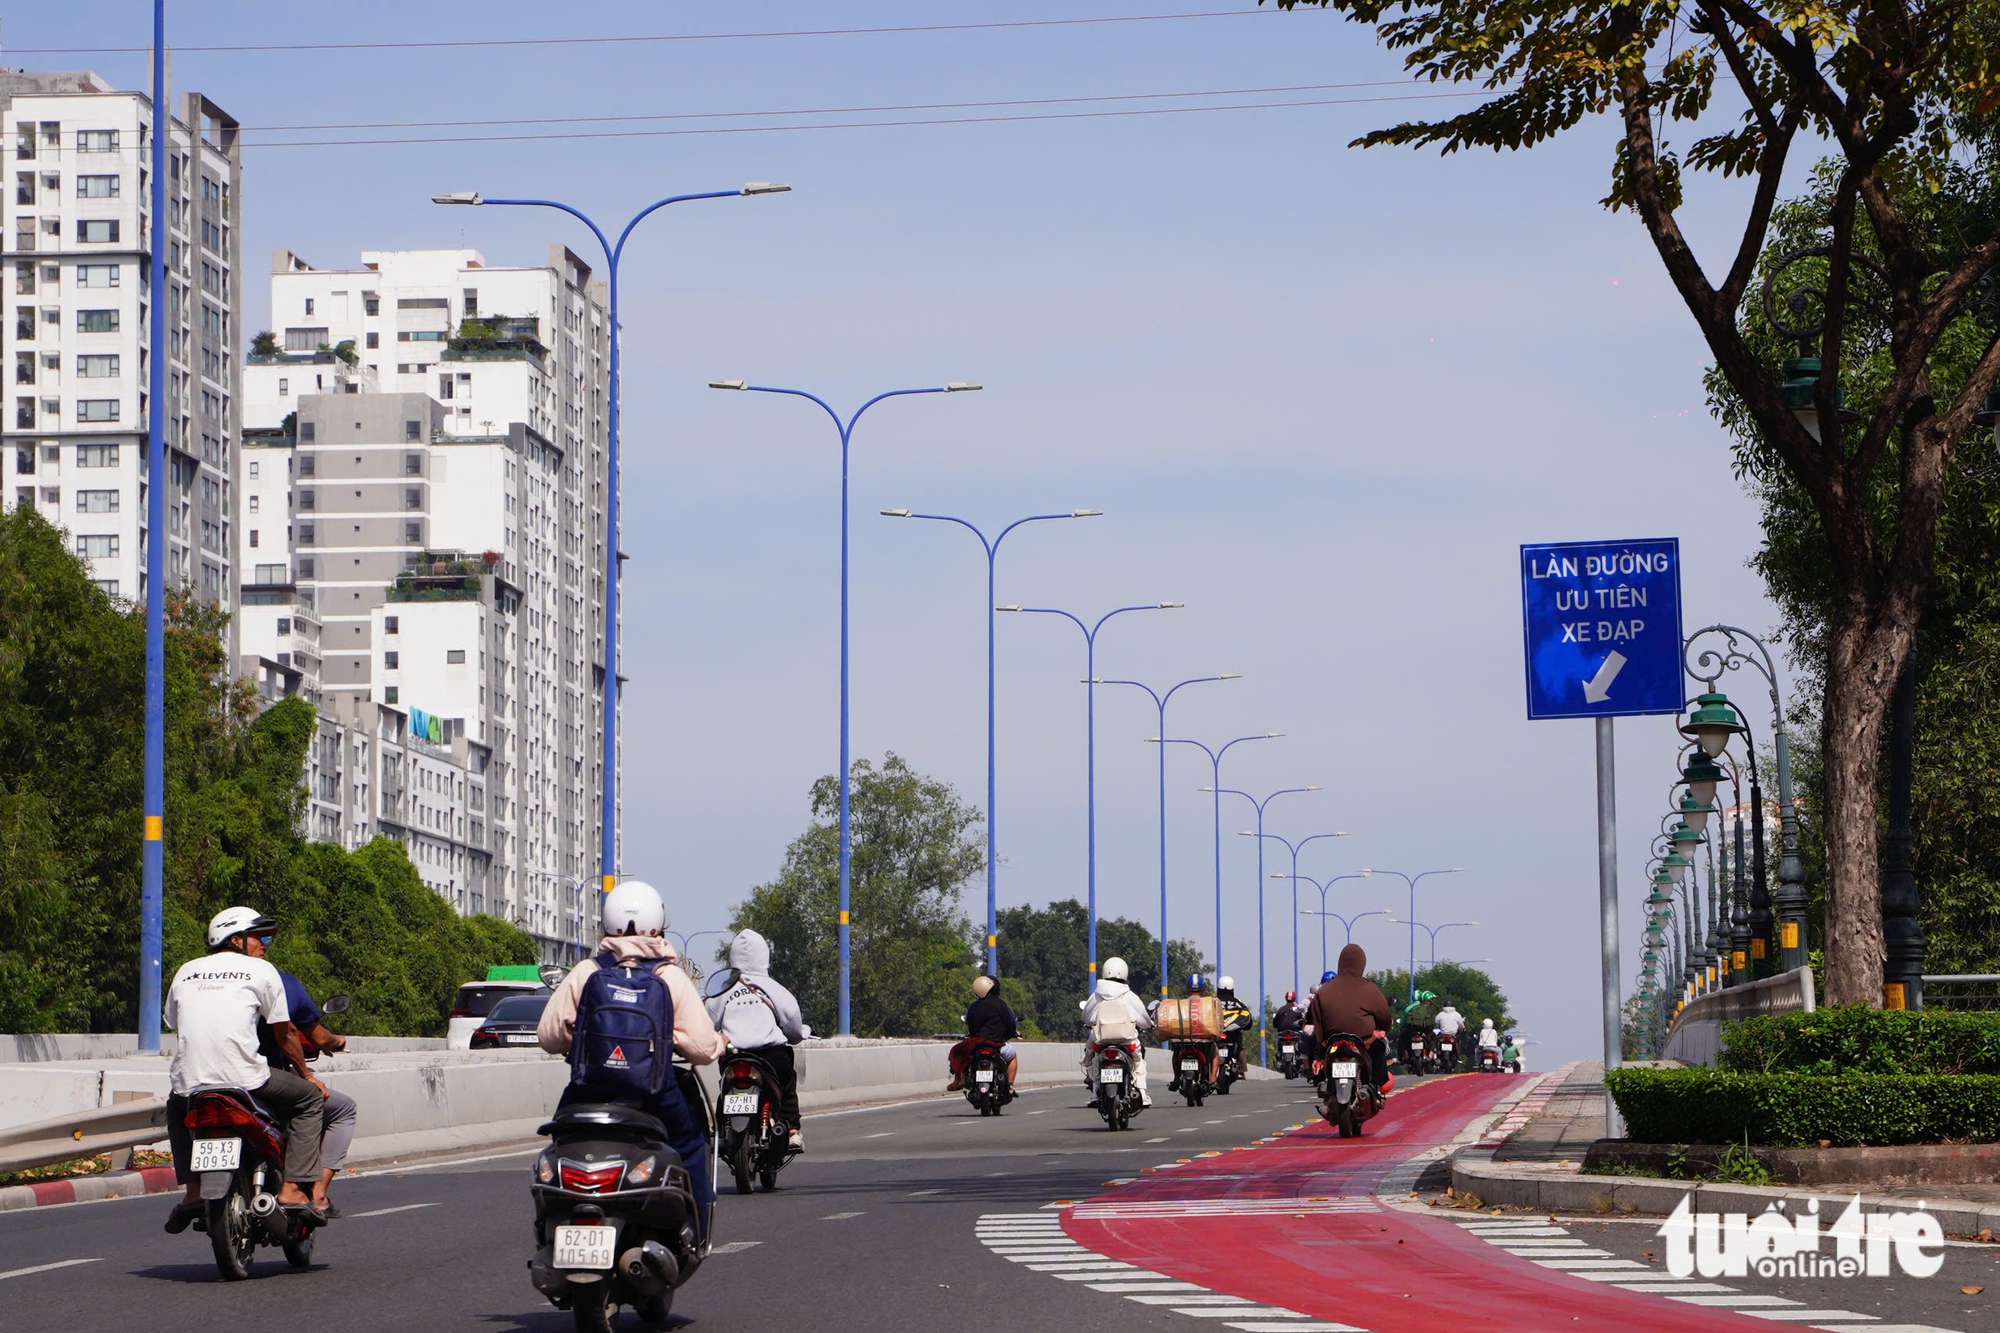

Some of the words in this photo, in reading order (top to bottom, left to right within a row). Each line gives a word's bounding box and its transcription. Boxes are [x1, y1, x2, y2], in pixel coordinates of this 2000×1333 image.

[1531, 552, 1579, 579] LÀN
[1585, 549, 1669, 577] ĐƯỜNG
[1556, 588, 1589, 611] ƯU
[1595, 583, 1648, 609] TIÊN
[1561, 621, 1591, 643] XE
[1596, 619, 1645, 645] ĐẠP
[202, 971, 252, 981] LEVENTS
[729, 1096, 753, 1104] 67-H1
[200, 1141, 234, 1155] 59-X3
[564, 1230, 604, 1247] 62-D1
